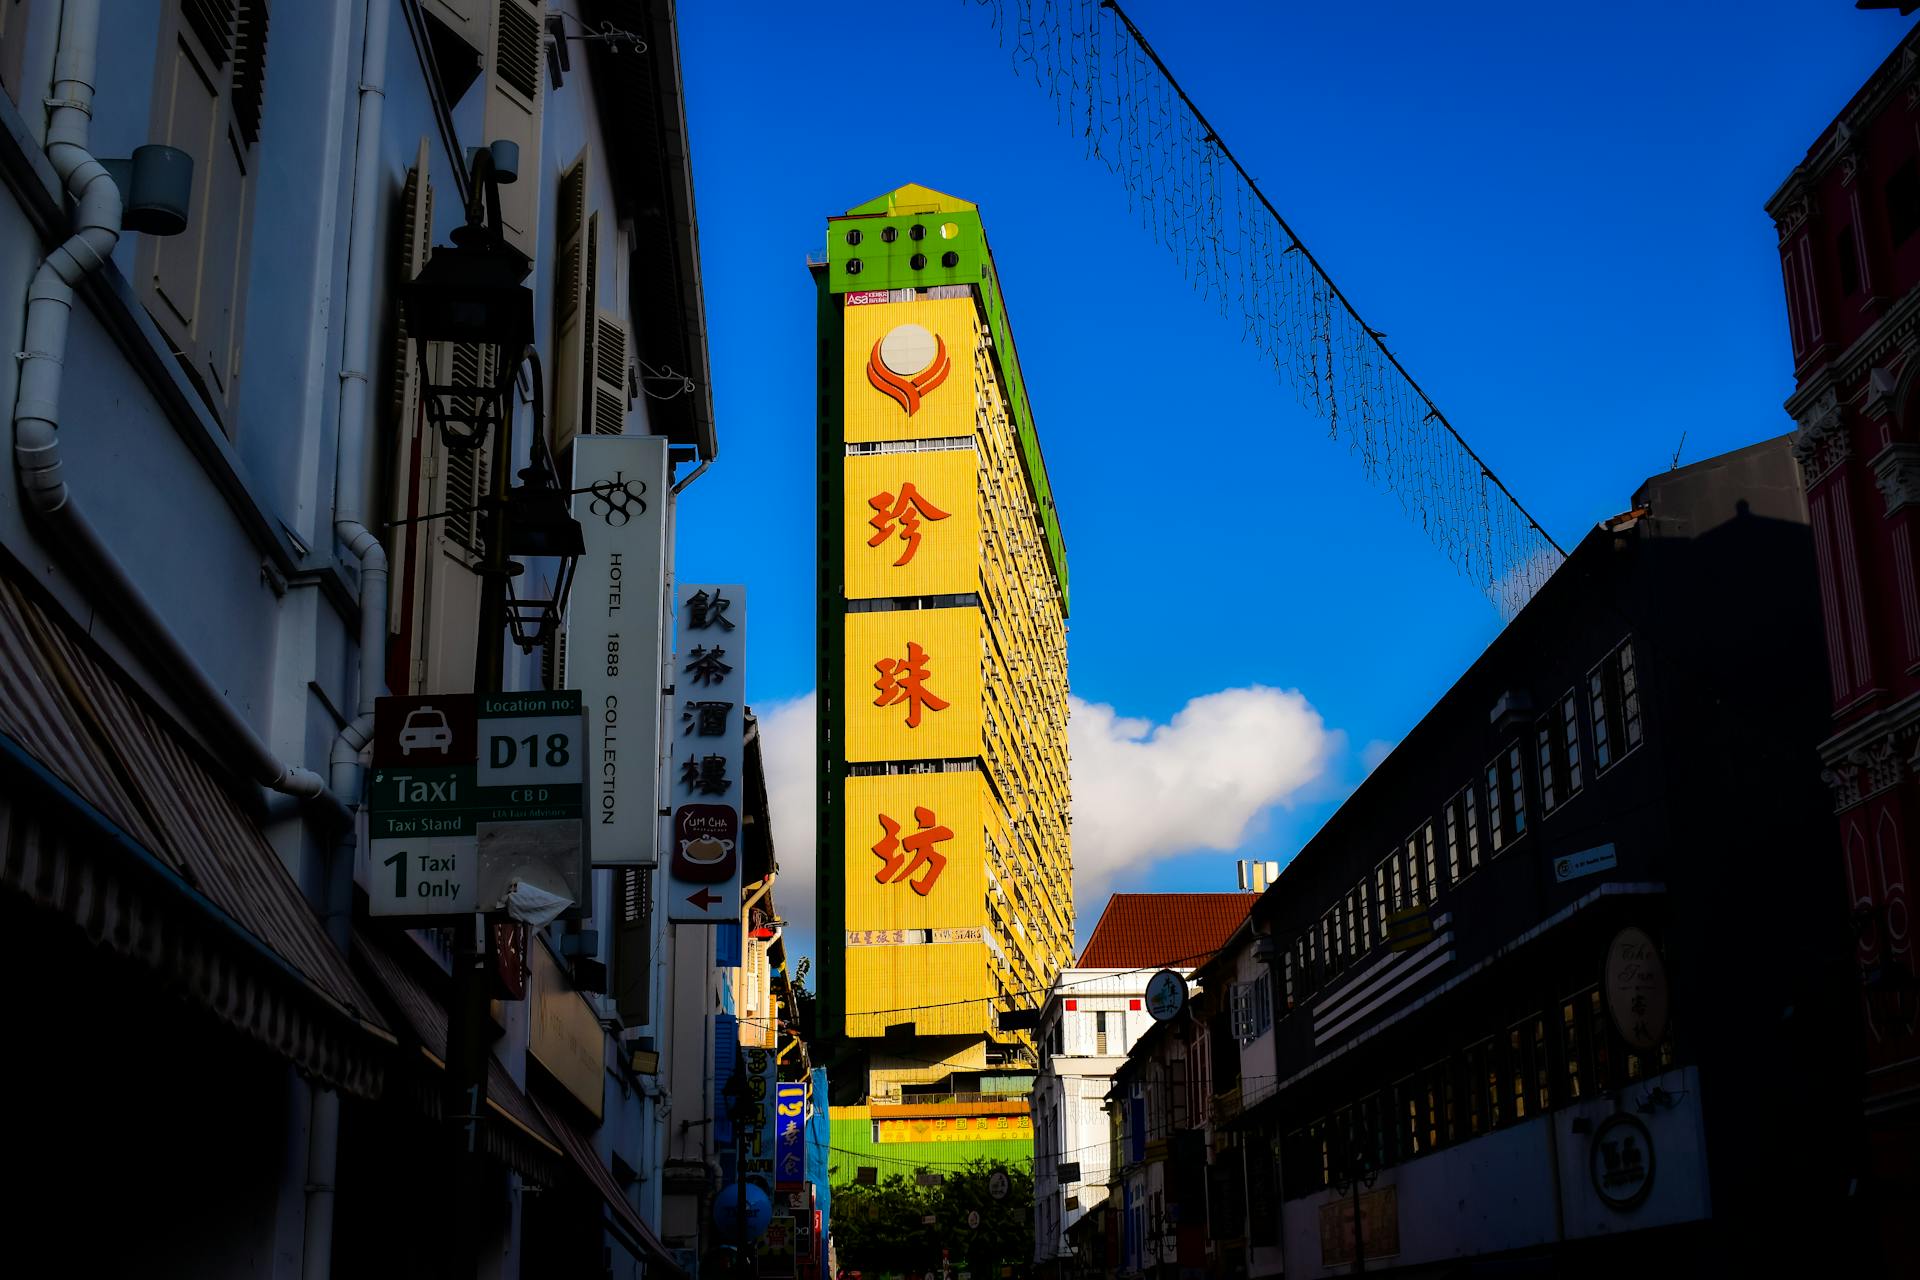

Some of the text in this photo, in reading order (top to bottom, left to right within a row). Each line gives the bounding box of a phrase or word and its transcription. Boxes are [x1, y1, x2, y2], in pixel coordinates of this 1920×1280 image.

[485, 698, 575, 713] Location no:
[602, 553, 622, 825] HOTEL 1888 COLLECTION
[681, 588, 736, 795] 飲茶酒樓
[867, 482, 954, 896] 珍珠坊
[490, 733, 570, 769] D18
[392, 773, 457, 803] Taxi
[386, 815, 462, 832] Taxi Stand
[682, 810, 728, 834] YUM CHA
[383, 851, 456, 898] 1 Taxi
[417, 879, 460, 901] Only
